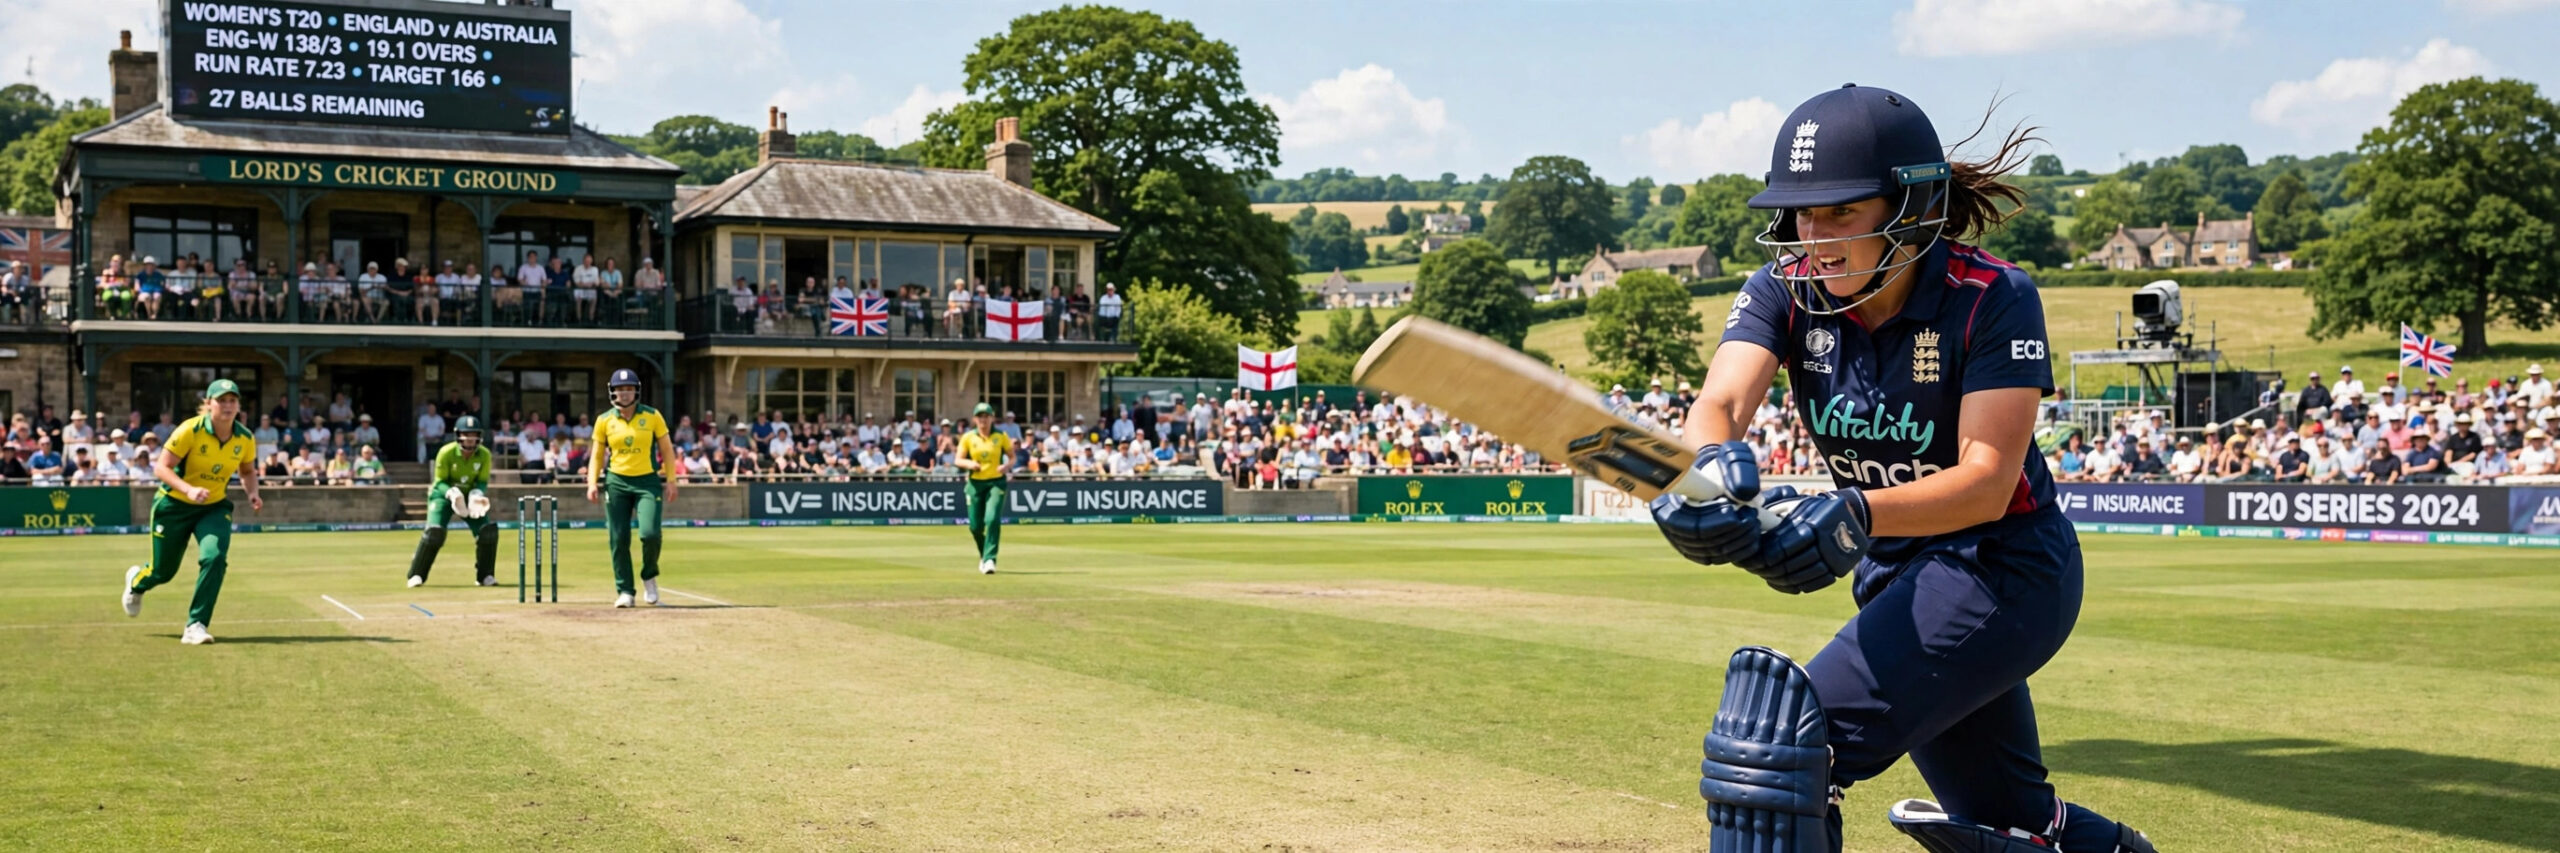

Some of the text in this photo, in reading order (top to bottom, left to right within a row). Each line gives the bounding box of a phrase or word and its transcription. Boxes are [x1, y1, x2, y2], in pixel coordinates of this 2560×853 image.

[184, 2, 557, 45] WOMEN'S T20 ENGLAND v AUSTRALIA
[206, 28, 477, 64] ENG-W 138/3 19.1 OVERS
[195, 53, 486, 88] RUN RATE 7.23 TARGET 166
[209, 88, 425, 119] 27 BALLS REMAINING
[229, 159, 556, 191] LORD'S CRICKET GROUND
[2011, 339, 2045, 360] ECB
[1809, 393, 1935, 455] Vitality
[765, 491, 956, 514] LV= INSURANCE
[1010, 489, 1207, 512] LV= INSURANCE
[1385, 502, 1444, 515] ROLEX
[1485, 502, 1546, 515] ROLEX
[2055, 491, 2185, 514] V= INSURANCE
[2227, 491, 2480, 526] IT20 SERIES 2024
[24, 513, 95, 528] ROLEX
